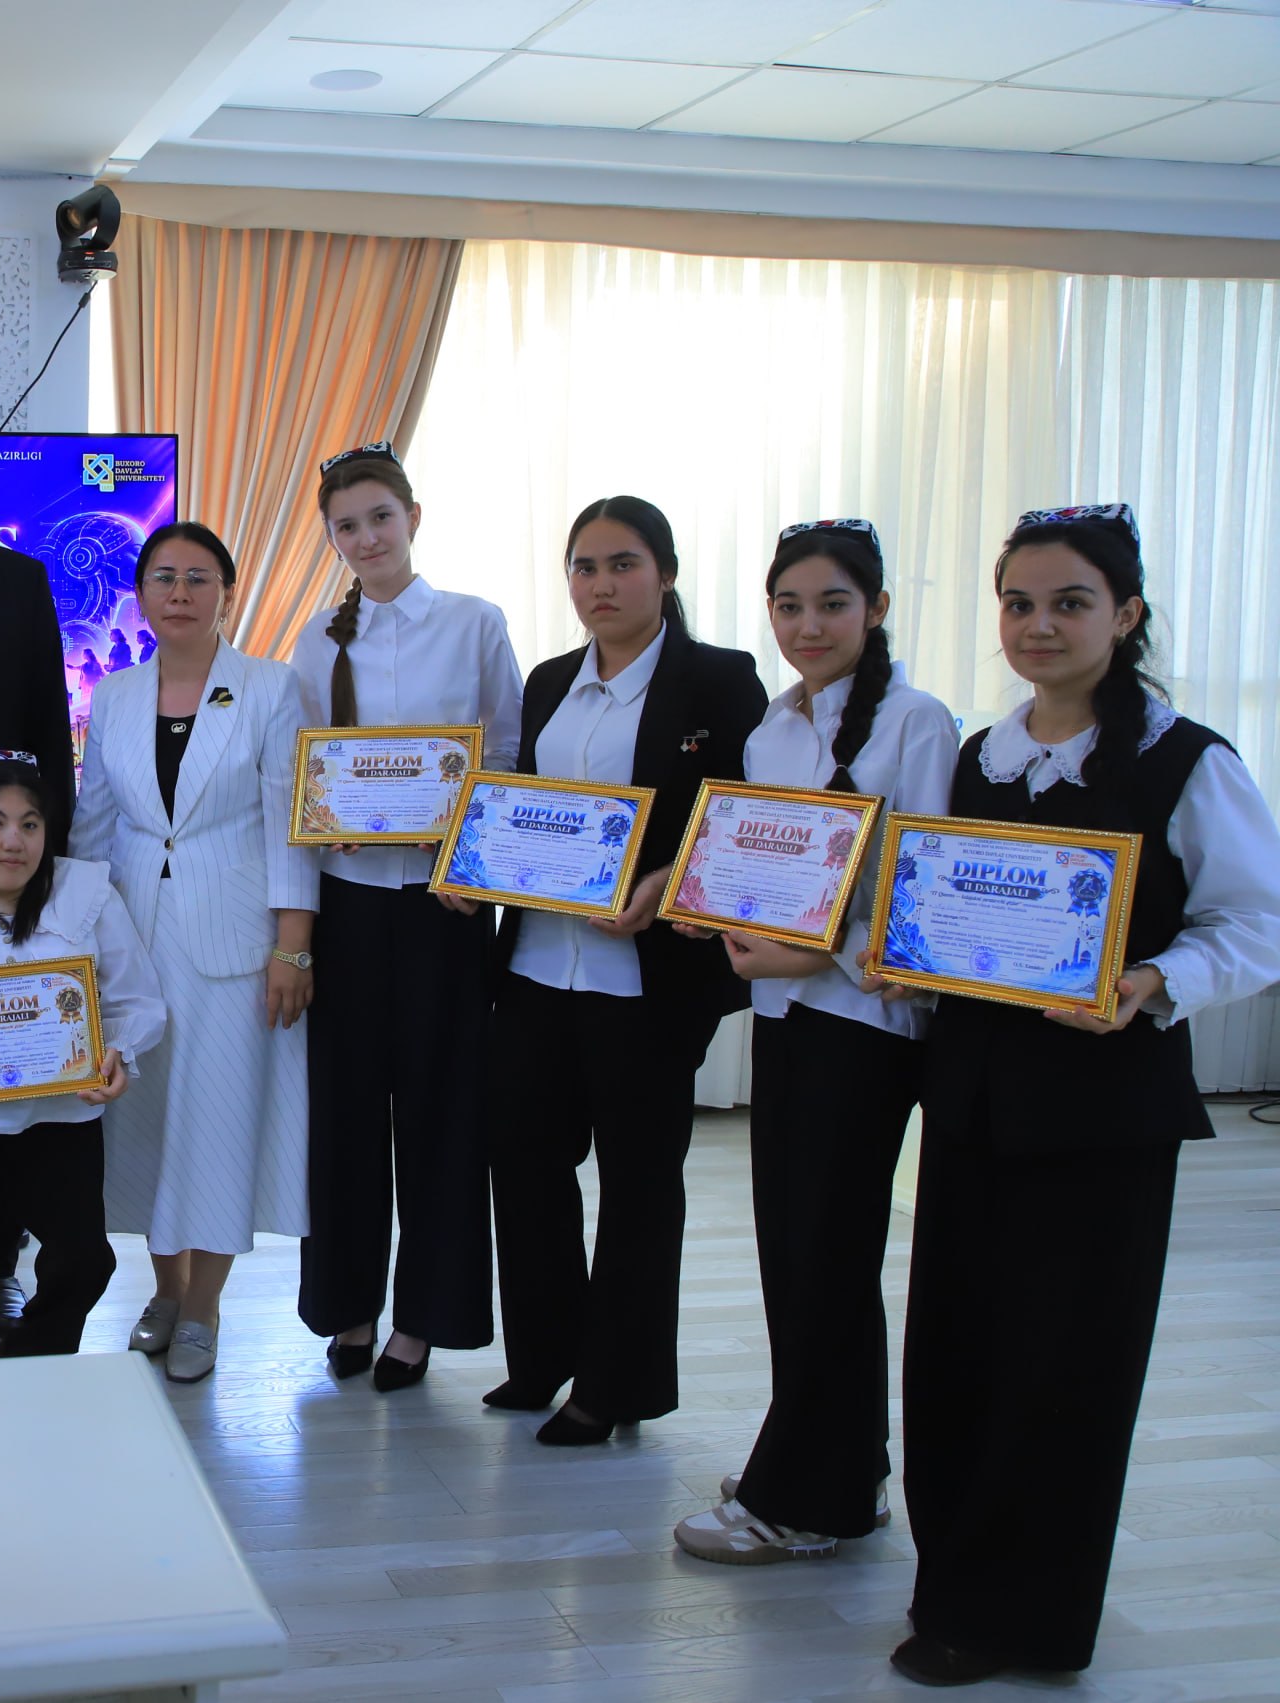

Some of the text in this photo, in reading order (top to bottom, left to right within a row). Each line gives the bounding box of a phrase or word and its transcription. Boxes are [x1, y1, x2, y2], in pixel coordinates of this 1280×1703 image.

[352, 755, 423, 768] DIPLOM
[370, 769, 411, 777] DARAJALI
[512, 805, 588, 826] DIPLOM
[528, 822, 571, 833] DARAJALI
[736, 820, 814, 843] DIPLOM
[742, 839, 798, 853] III DARAJALI
[952, 860, 1048, 887] DIPLOM
[963, 882, 1030, 898] II DARAJALI
